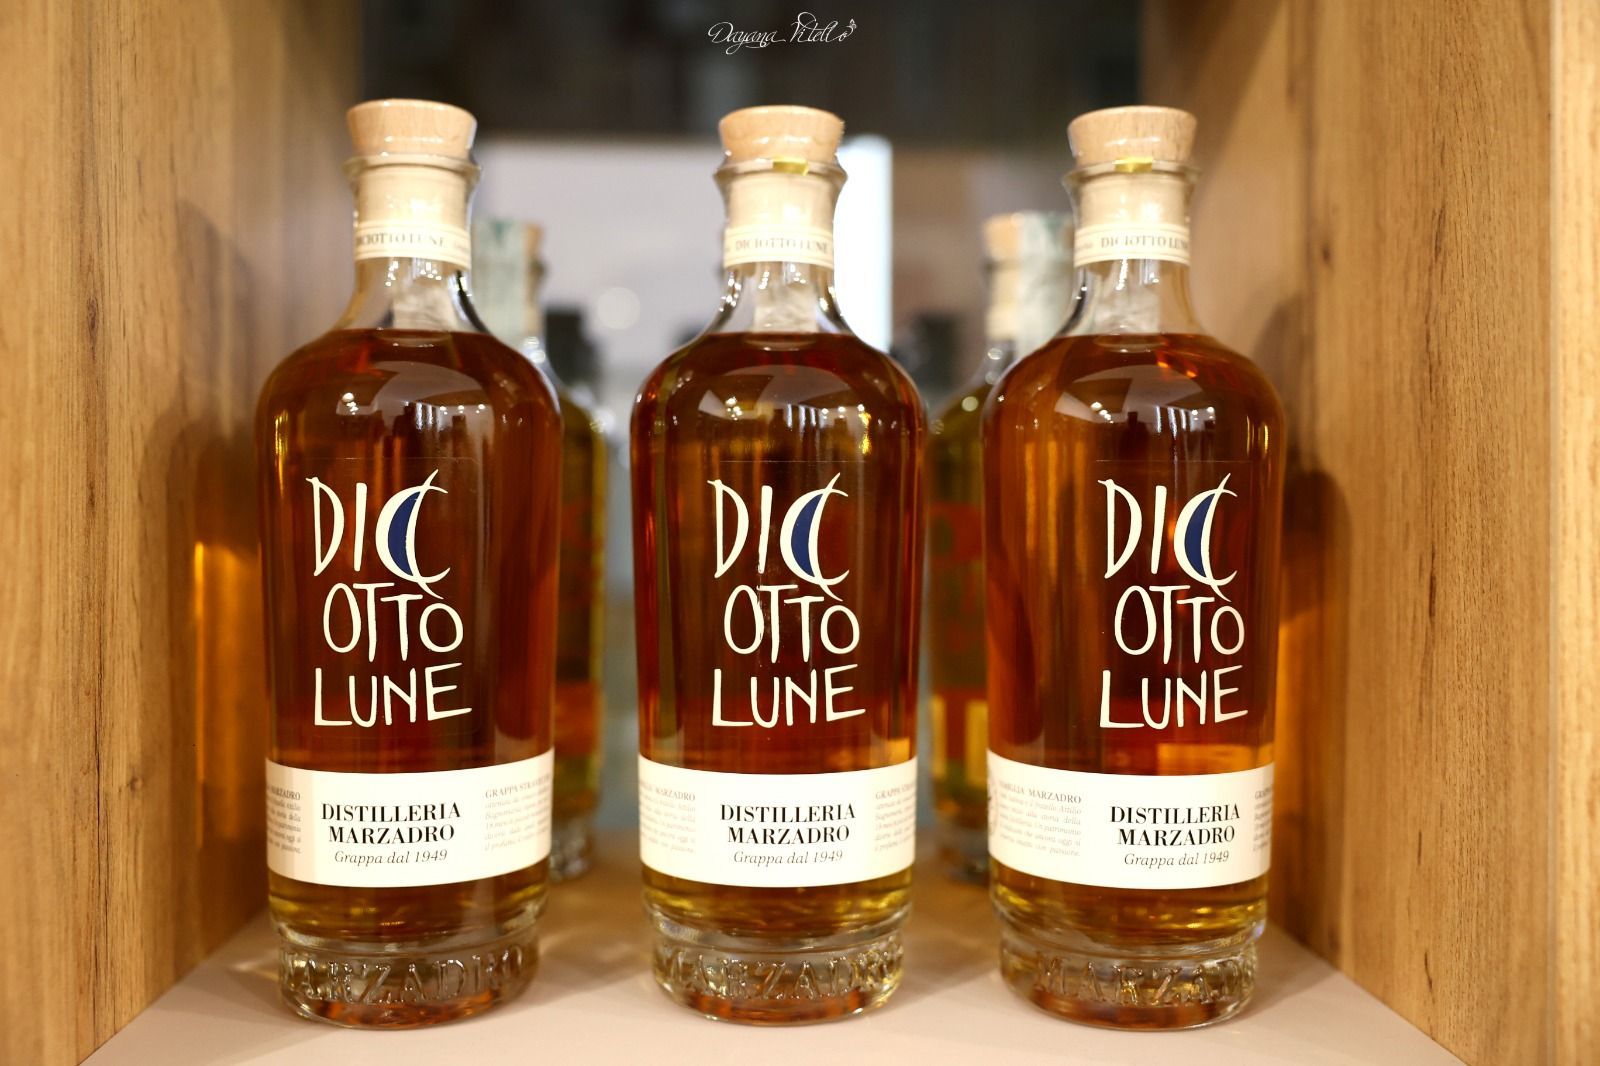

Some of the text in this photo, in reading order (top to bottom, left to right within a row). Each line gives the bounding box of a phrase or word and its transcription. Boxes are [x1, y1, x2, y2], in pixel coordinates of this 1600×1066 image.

[323, 582, 464, 662] OTTO
[724, 584, 860, 664] OTTO
[1114, 585, 1245, 665] OTTO
[314, 662, 472, 728] LUNE
[712, 663, 866, 728] LUNE
[1099, 665, 1248, 730] LUNE
[1028, 787, 1082, 804] MARZADRO
[321, 802, 461, 823] DISTILLERIA
[720, 803, 856, 824] DISTILLERIA
[1110, 803, 1241, 825] DISTILLERIA
[328, 824, 455, 845] MARZADRO
[728, 825, 850, 845] MARZADRO
[1117, 826, 1235, 847] MARZADRO
[334, 849, 448, 867] Grappa dal 1949
[733, 850, 843, 867] Grappa dal 1949
[1124, 850, 1230, 870] Grappa dal 1949
